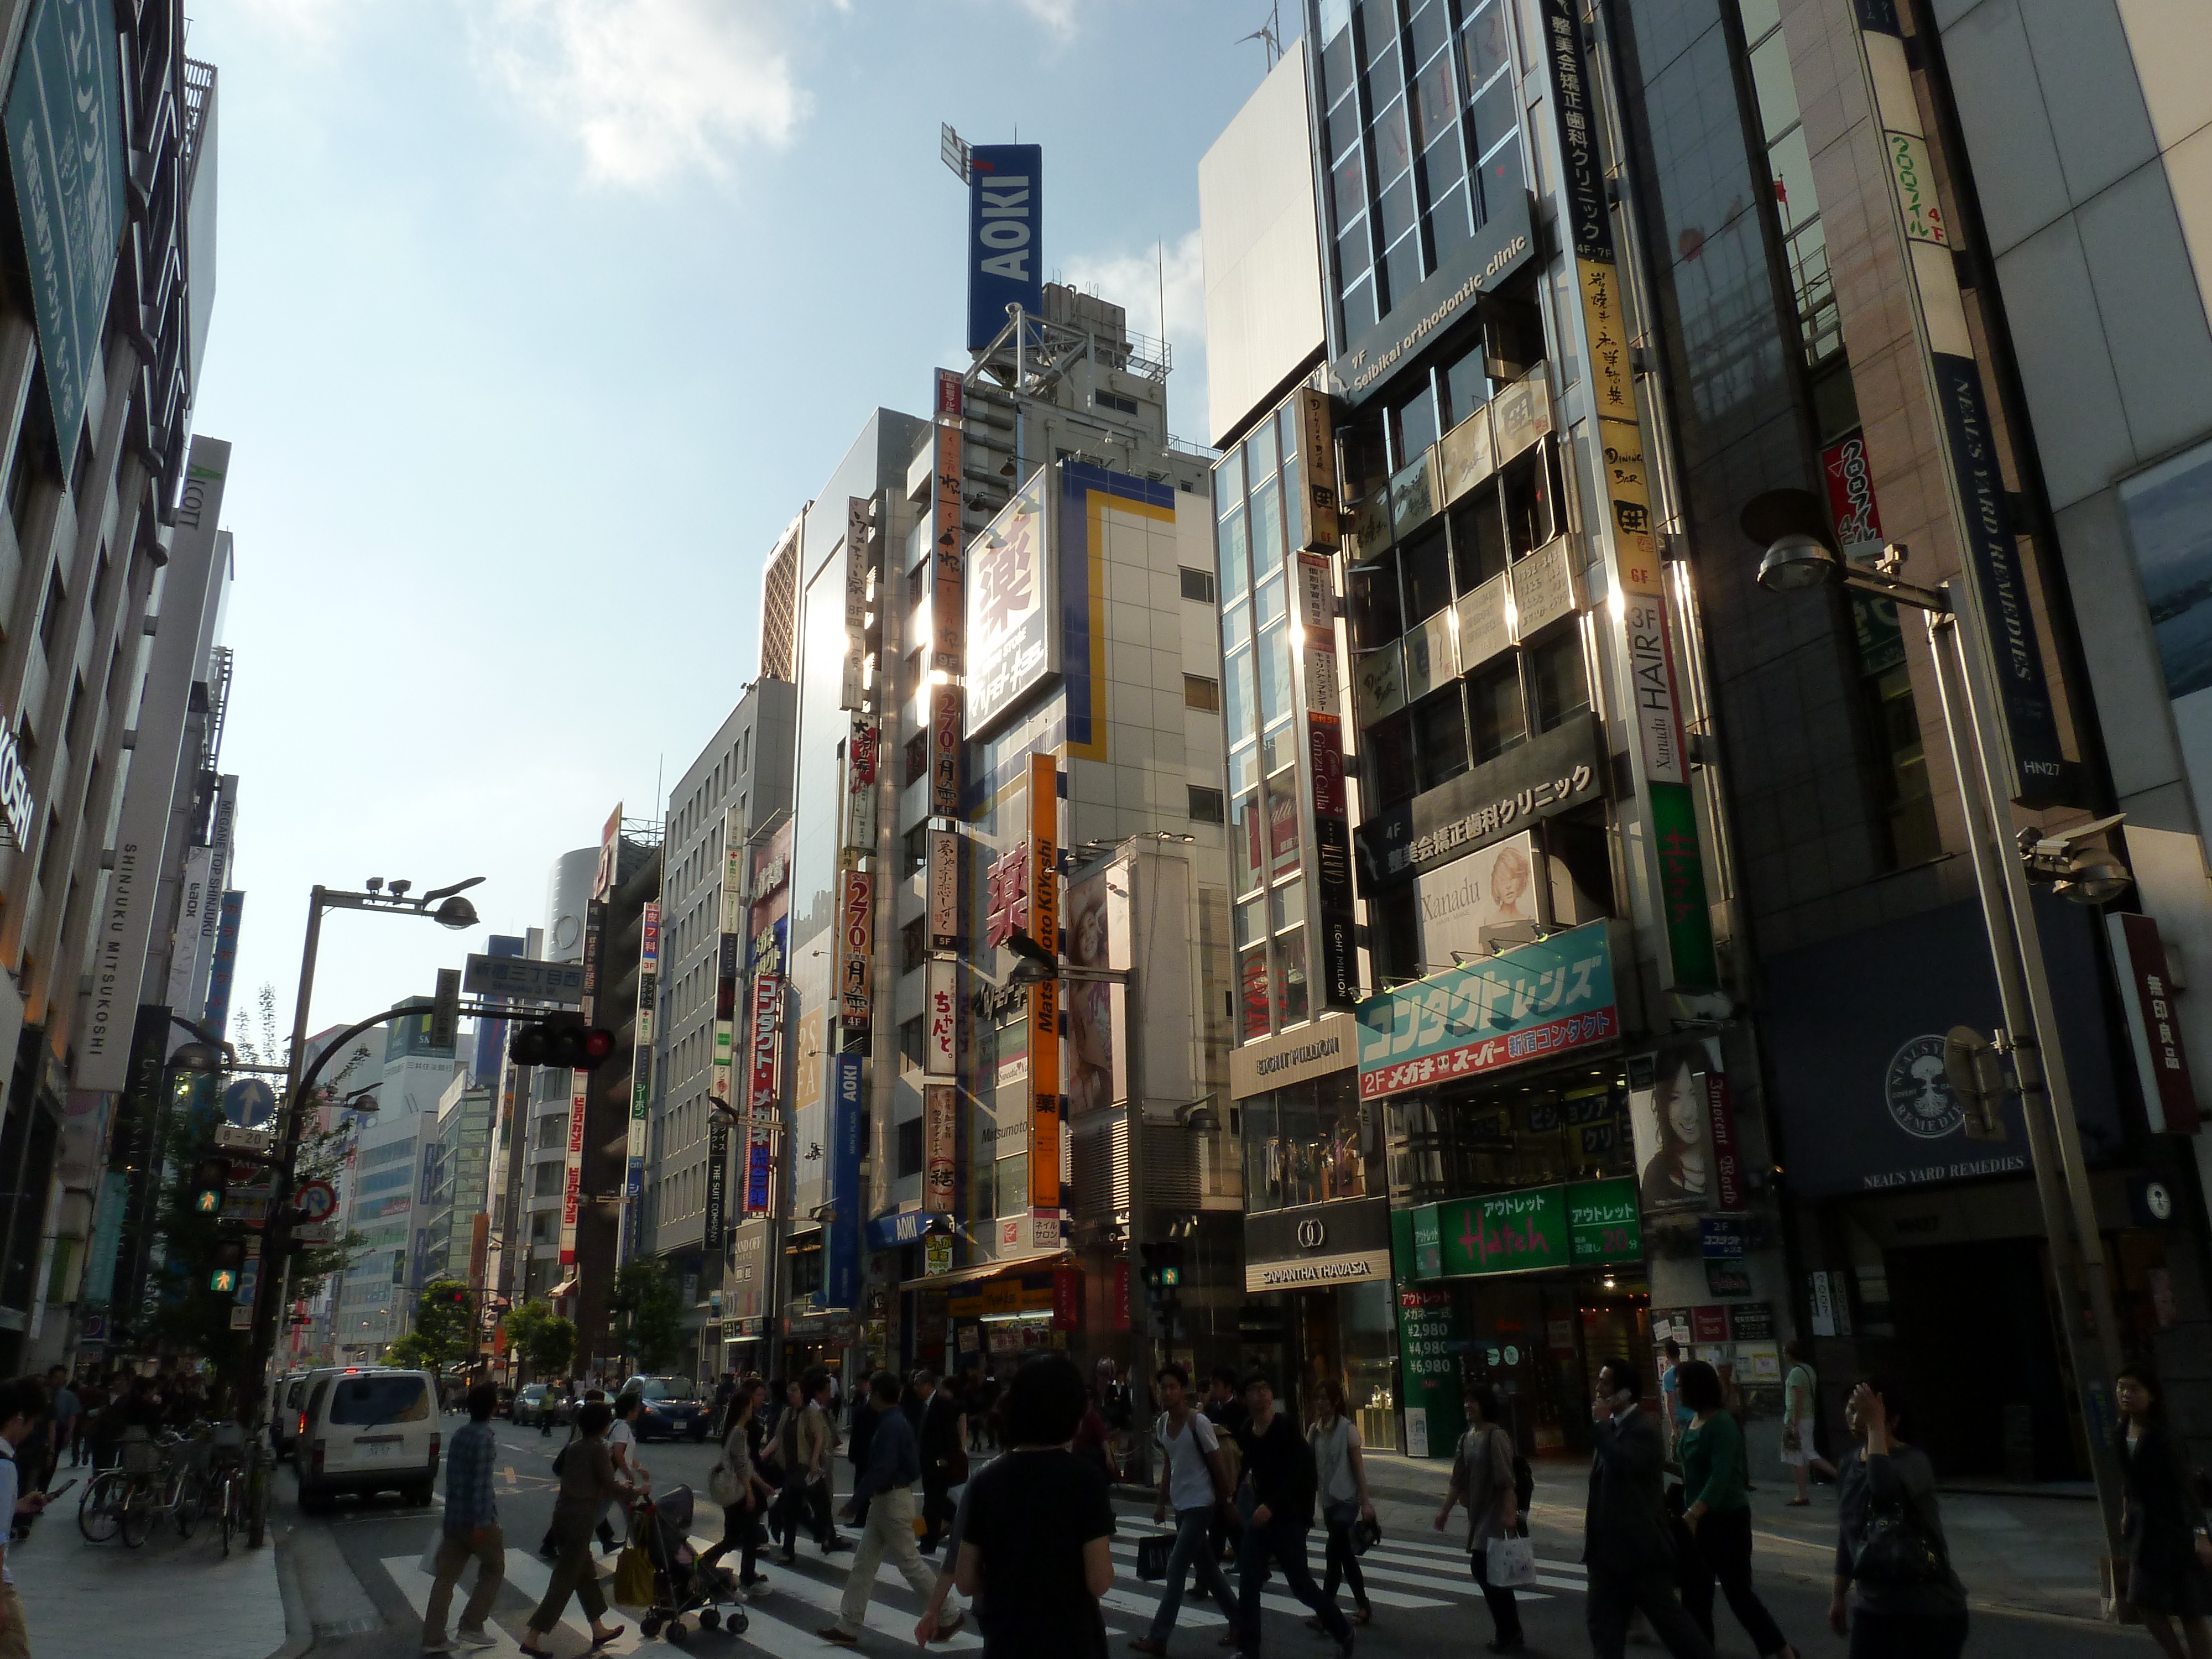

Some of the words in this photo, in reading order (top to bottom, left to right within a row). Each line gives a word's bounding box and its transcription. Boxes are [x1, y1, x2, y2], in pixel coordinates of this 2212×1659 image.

[65, 0, 109, 311] ュンク堂書店
[980, 175, 1030, 282] AOKI
[1354, 341, 1402, 392] Seibikai
[1404, 273, 1483, 348] orthodontic
[1486, 235, 1526, 276] clinic
[1352, 348, 1367, 369] 7F
[1631, 568, 1649, 583] 6F
[1971, 468, 2000, 535] YARD
[1990, 549, 2032, 681] REMEDIES
[849, 605, 863, 615] 8F
[1631, 607, 1656, 630] 3F
[1634, 634, 1669, 711] HAIR
[1313, 731, 1326, 772] Ginza
[1651, 718, 1671, 770] Xanadu
[1316, 775, 1329, 810] Calla
[1386, 822, 1402, 840] 4F
[111, 843, 137, 932] SHINJUKU
[1421, 877, 1480, 922] Xanadu
[201, 877, 220, 937] SHINJUKU
[644, 912, 659, 952] 皮フ科
[1333, 924, 1344, 953] EIGHT
[1335, 954, 1346, 998] MILLION
[90, 941, 121, 1056] MITSUKOSHI
[1364, 955, 1601, 1062] コンタクトレンズ
[847, 1016, 862, 1026] 4F
[1364, 1068, 1386, 1094] 2F
[1507, 1013, 1609, 1058] 新宿コンタクト
[843, 1065, 858, 1102] AOKI
[982, 1120, 1028, 1144] Matsumoto
[713, 1164, 722, 1180] THE
[1863, 1170, 1907, 1190] NEAL'S
[1909, 1165, 1945, 1185] YARD
[1948, 1155, 2026, 1178] REMEDIES
[711, 1181, 722, 1198] SUIT
[708, 1199, 721, 1244] COMPANY
[1484, 1194, 1546, 1218] アウトレット
[1572, 1203, 1634, 1224] アウトレット
[896, 1215, 917, 1241] AOKI
[1035, 1220, 1058, 1230] ネイル
[1035, 1231, 1058, 1239] サロン
[1458, 1206, 1550, 1265] Hatch
[1262, 1264, 1316, 1284] SAMANTHA
[1316, 1260, 1370, 1280] THAVASA
[1401, 1291, 1452, 1305] アウトレット
[1407, 1323, 1448, 1338] ¥2,980
[1408, 1341, 1447, 1357] ¥4,980
[1410, 1359, 1451, 1375] ¥6,980
